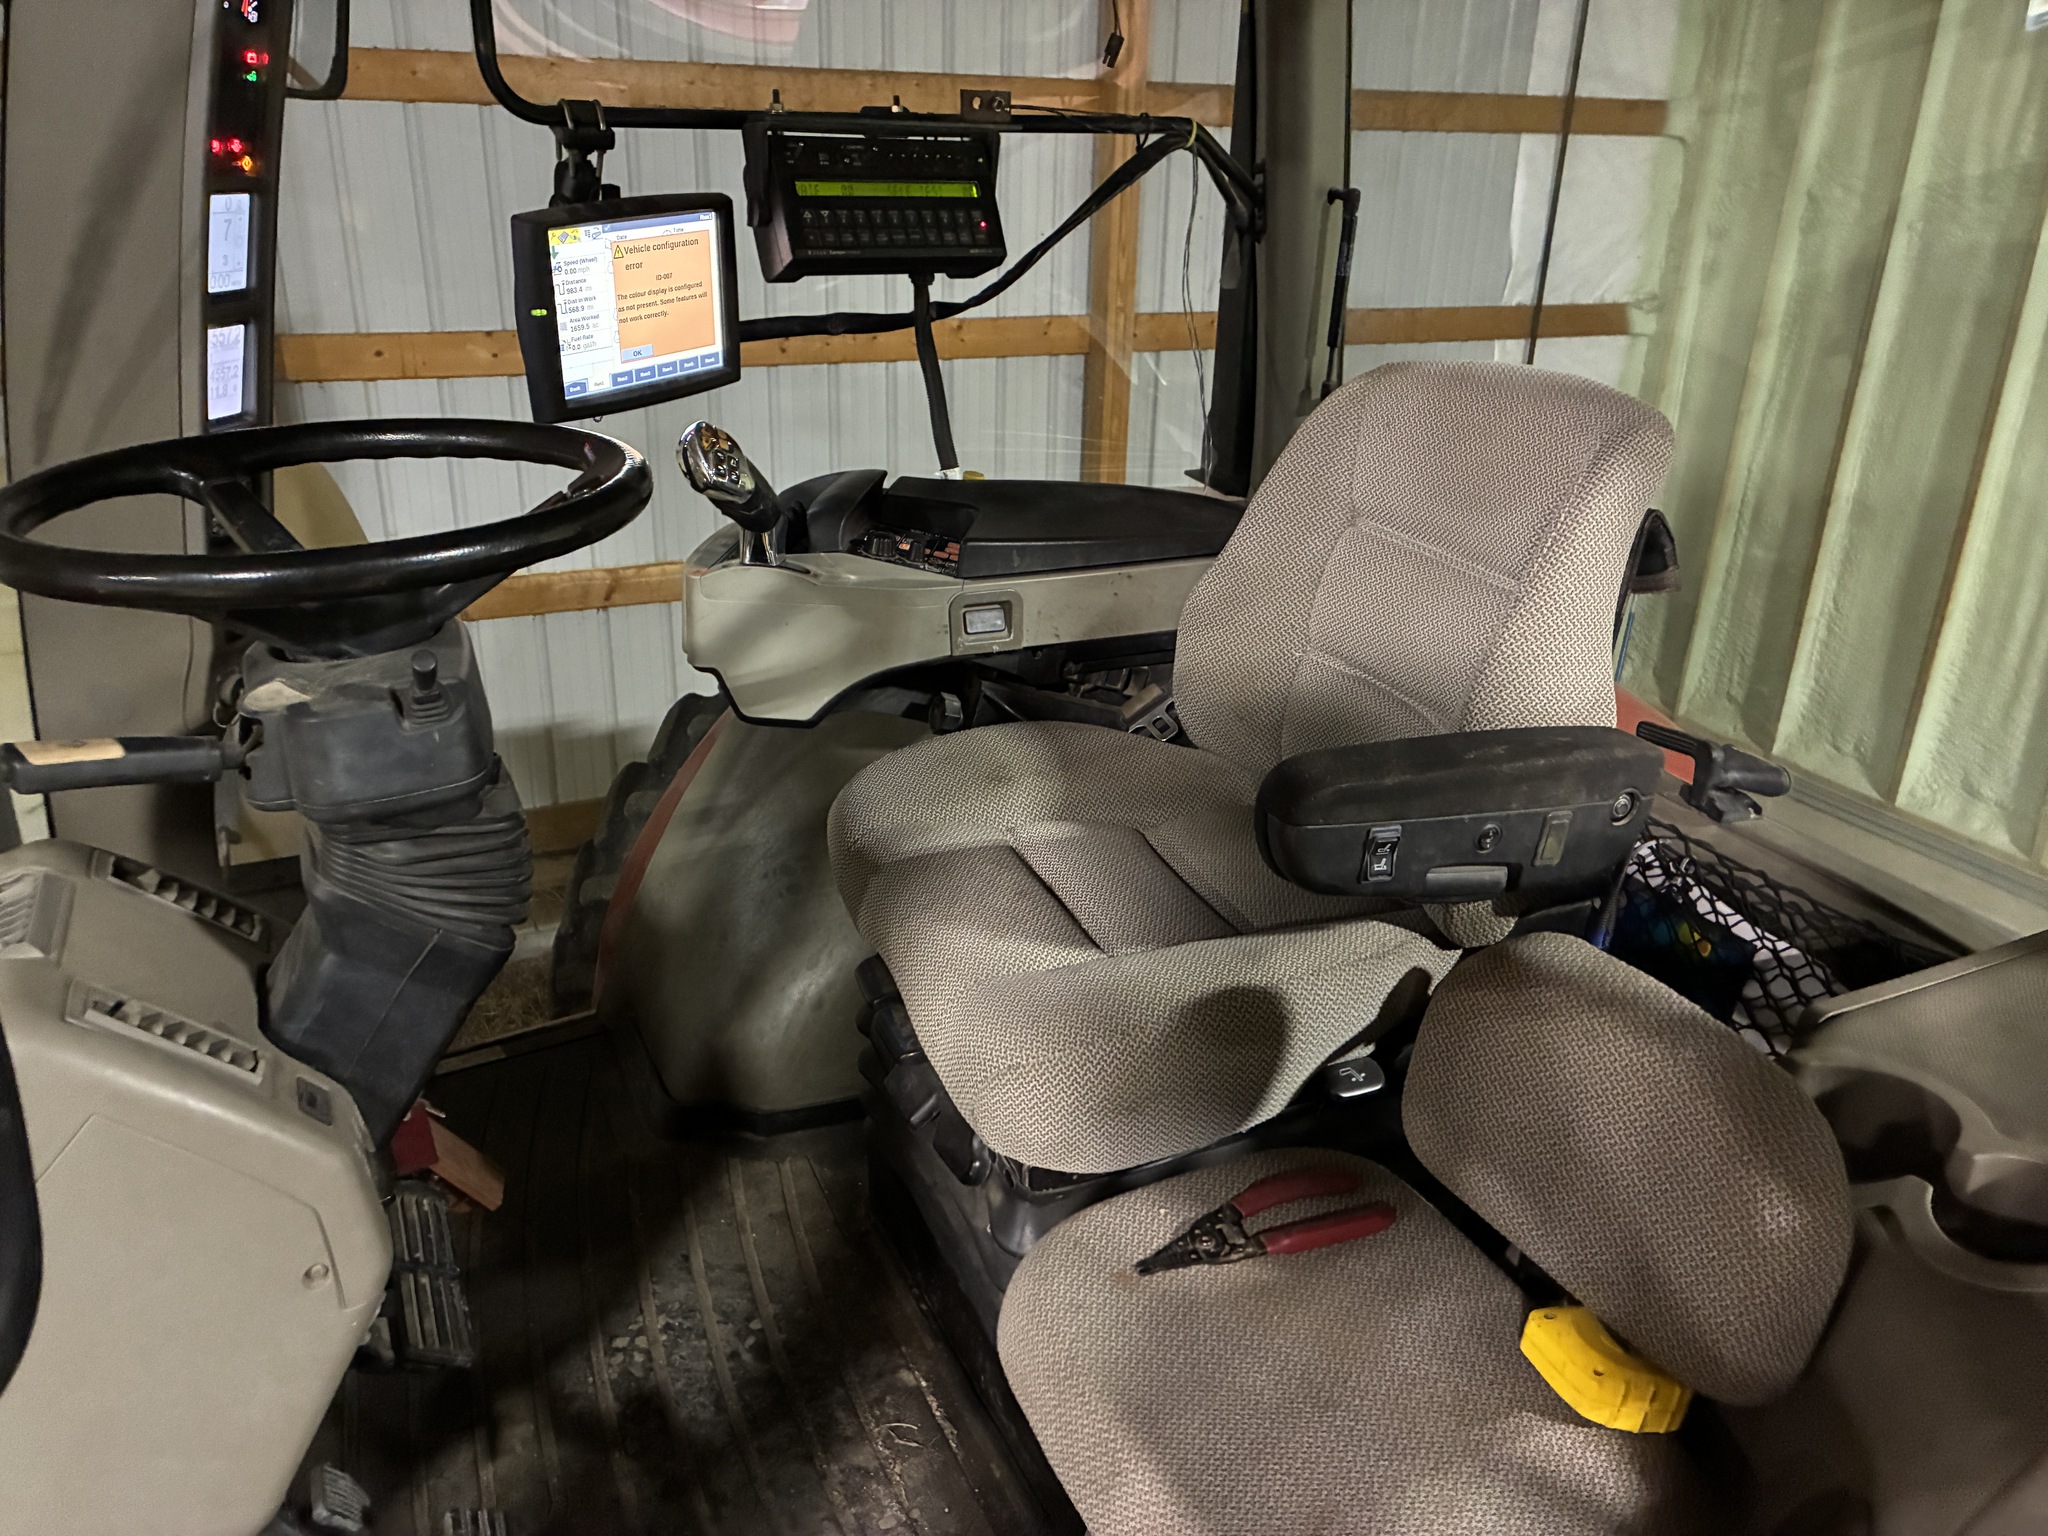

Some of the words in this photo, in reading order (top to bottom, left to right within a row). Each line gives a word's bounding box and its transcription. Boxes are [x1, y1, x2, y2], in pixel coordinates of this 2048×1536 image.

[224, 218, 232, 241] 7
[623, 244, 651, 255] Vehicle
[652, 238, 699, 251] configuration
[563, 259, 578, 267] Speed
[579, 257, 598, 266] (Wheel)
[625, 261, 643, 271] error
[655, 272, 673, 281] ID-007
[565, 278, 587, 286] Distance
[566, 286, 583, 295] 983.4
[628, 290, 647, 298] colour
[647, 286, 668, 297] display
[674, 281, 703, 292] configured
[636, 300, 659, 310] present.
[660, 297, 675, 305] Some
[675, 293, 698, 302] features
[568, 305, 585, 314] 568.9
[581, 314, 600, 322] Worked
[618, 316, 629, 324] not
[629, 313, 643, 322] work
[643, 310, 669, 320] correctly.
[570, 323, 590, 332] 1659.5
[571, 343, 581, 351] 0.0
